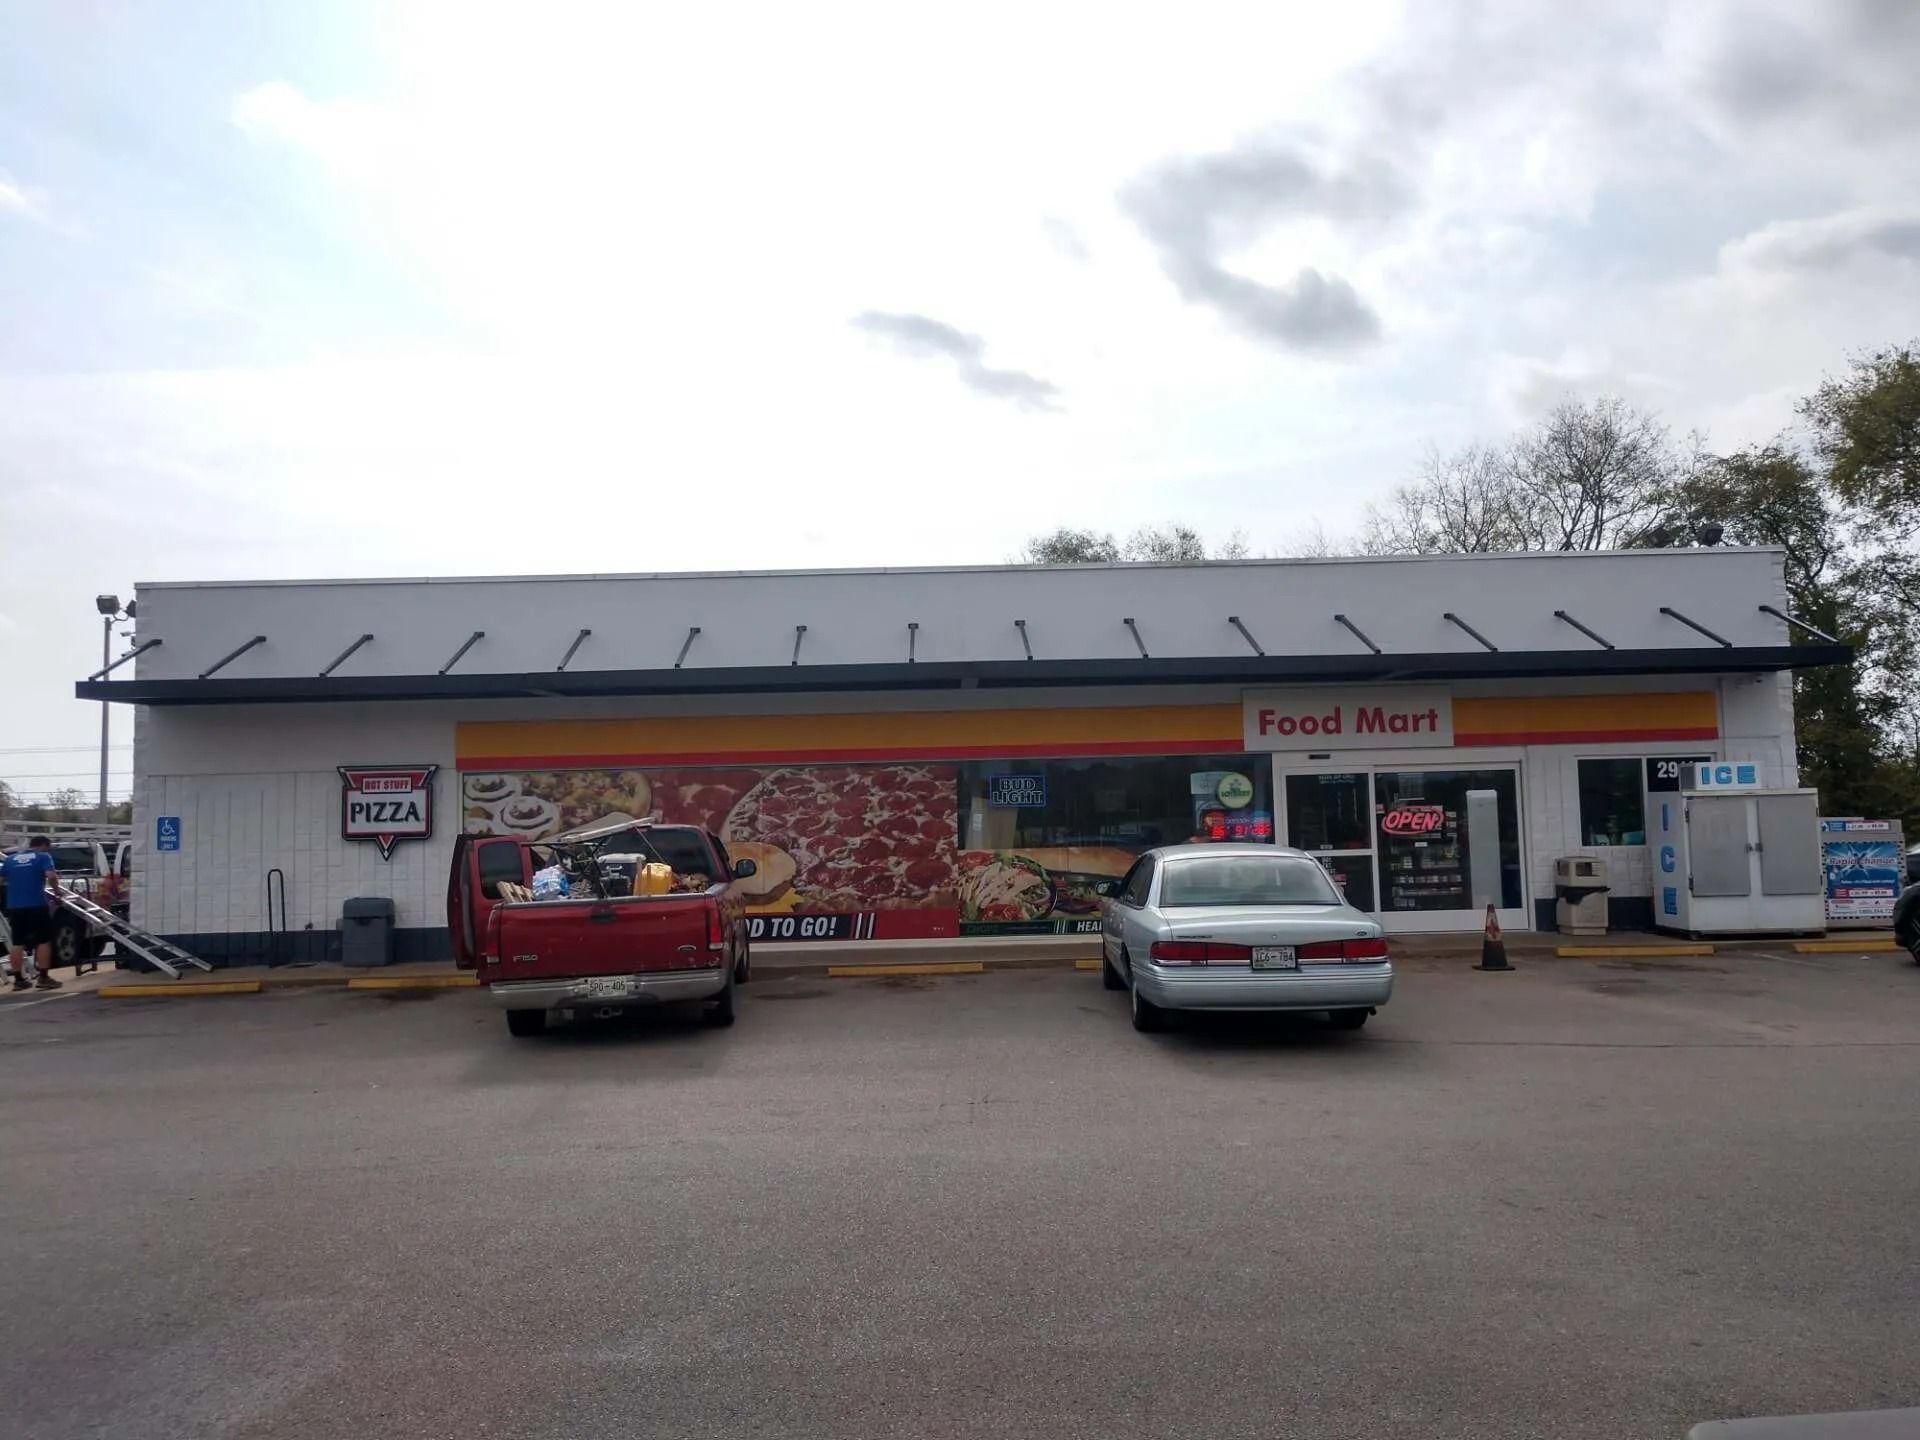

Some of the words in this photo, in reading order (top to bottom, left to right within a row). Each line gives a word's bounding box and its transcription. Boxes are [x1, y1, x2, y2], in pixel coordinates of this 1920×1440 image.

[1258, 704, 1342, 736] Food
[1356, 707, 1438, 733] Mart
[364, 780, 381, 790] HOT
[383, 779, 409, 790] STUFF
[1000, 778, 1036, 791] BUD
[1701, 765, 1757, 785] ICE
[992, 790, 1043, 805] LIGHT
[350, 801, 420, 823] PIZZA
[1386, 811, 1437, 831] OPEN
[771, 917, 796, 937] TO
[801, 917, 837, 937] GO!
